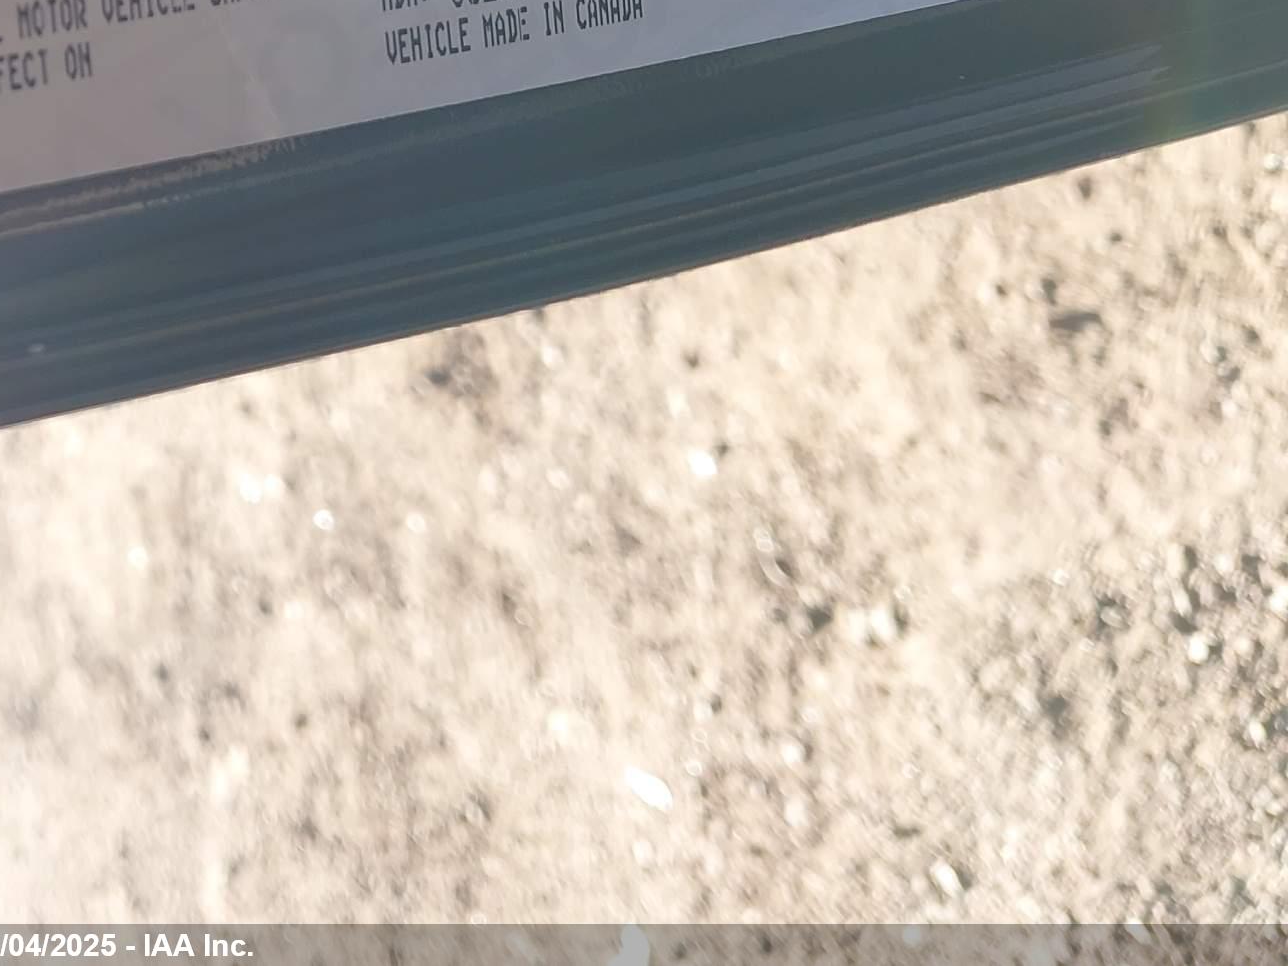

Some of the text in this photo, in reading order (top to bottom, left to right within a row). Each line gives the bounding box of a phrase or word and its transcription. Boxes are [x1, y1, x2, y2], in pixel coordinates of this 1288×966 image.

[384, 17, 472, 65] VEHICLE
[481, 5, 531, 48] MADE
[64, 41, 94, 81] ON
